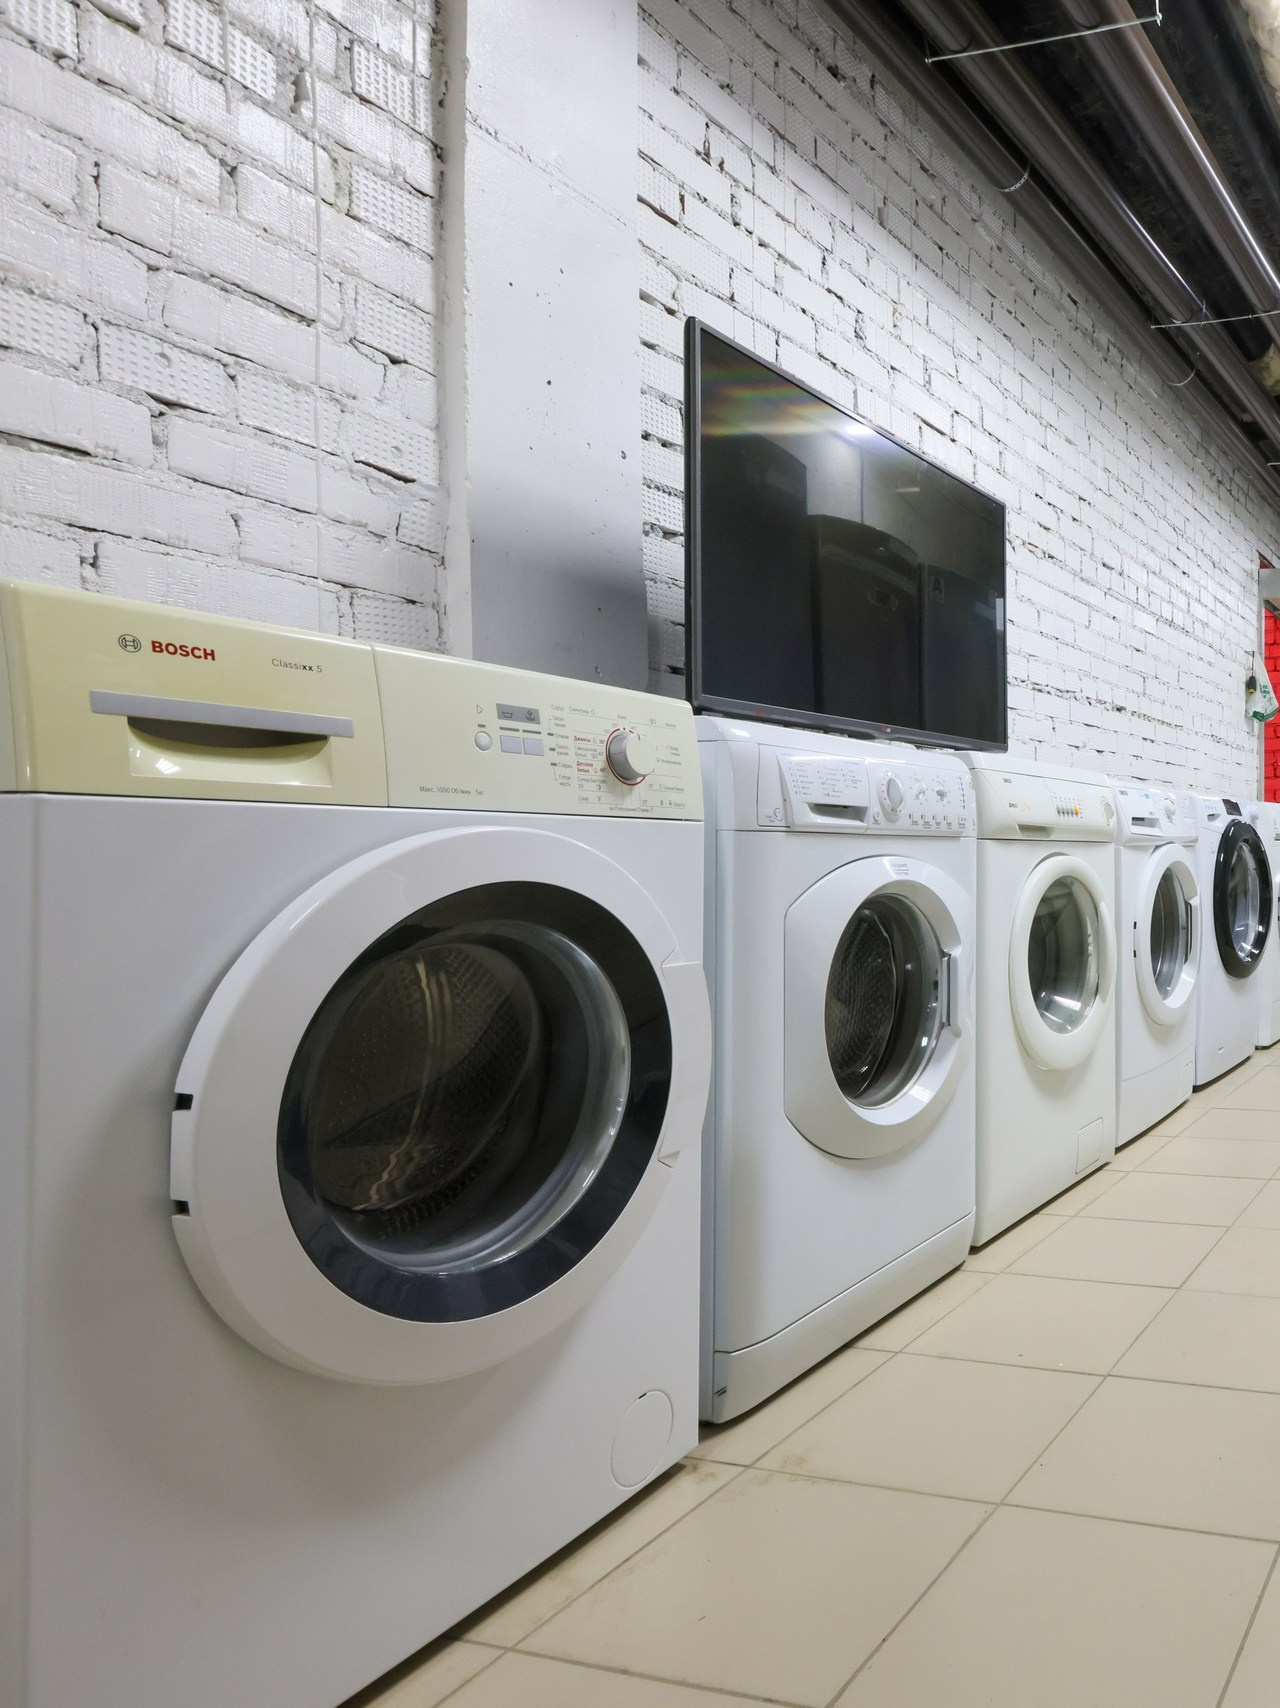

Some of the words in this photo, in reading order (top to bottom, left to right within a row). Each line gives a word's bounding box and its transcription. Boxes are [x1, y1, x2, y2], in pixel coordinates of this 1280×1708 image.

[151, 640, 216, 661] BOSCH
[271, 658, 314, 672] Classixx
[317, 664, 323, 673] 5
